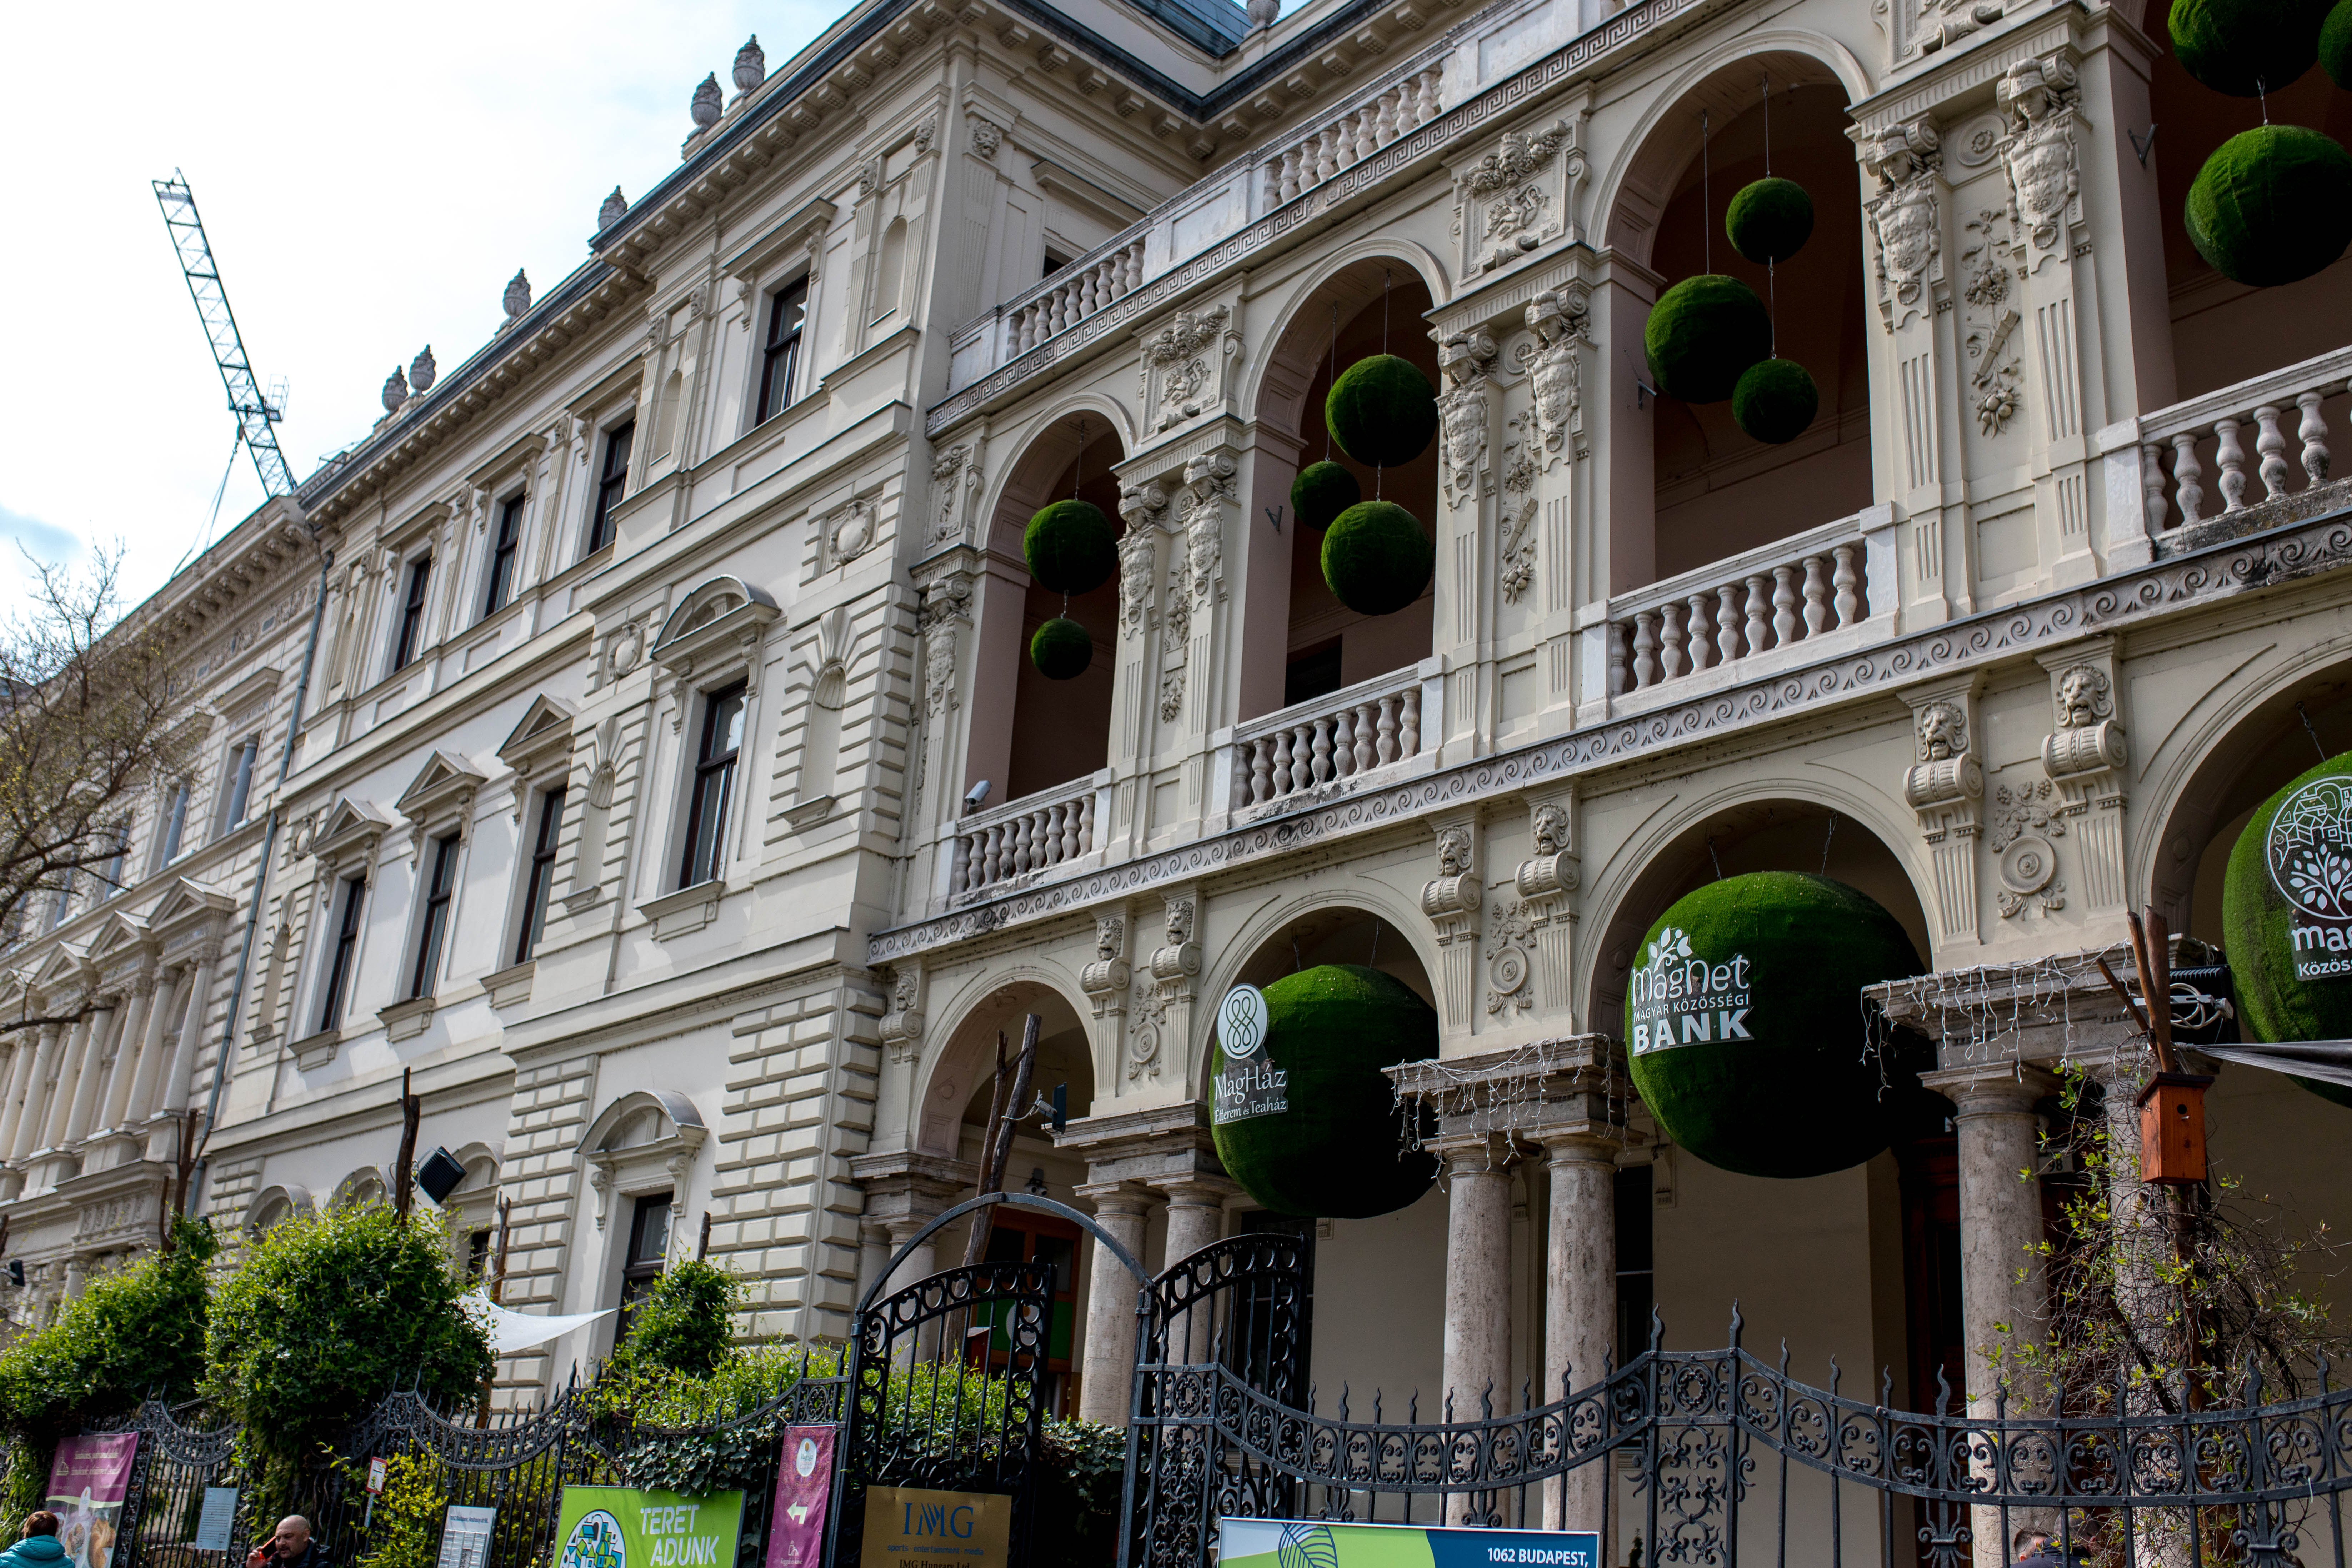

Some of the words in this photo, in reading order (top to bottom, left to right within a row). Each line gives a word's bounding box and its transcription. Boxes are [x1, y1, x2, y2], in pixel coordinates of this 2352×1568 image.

[1633, 1004, 1669, 1022] MAGYAR
[1673, 993, 1749, 1013] KÖZÖSSÉGI
[1634, 1008, 1750, 1053] BANK
[1214, 1063, 1286, 1104] MagHáz
[1215, 1107, 1241, 1122] Étterem
[1243, 1107, 1249, 1115] és
[1249, 1097, 1286, 1113] Teaház
[640, 1504, 699, 1535] TERET
[902, 1502, 974, 1538] IMG
[650, 1536, 719, 1566] ADUNK
[899, 1559, 918, 1568] IMG
[914, 1546, 960, 1554] entertainment
[1487, 1547, 1515, 1562] 1062
[1518, 1548, 1588, 1568] BUDAPEST,
